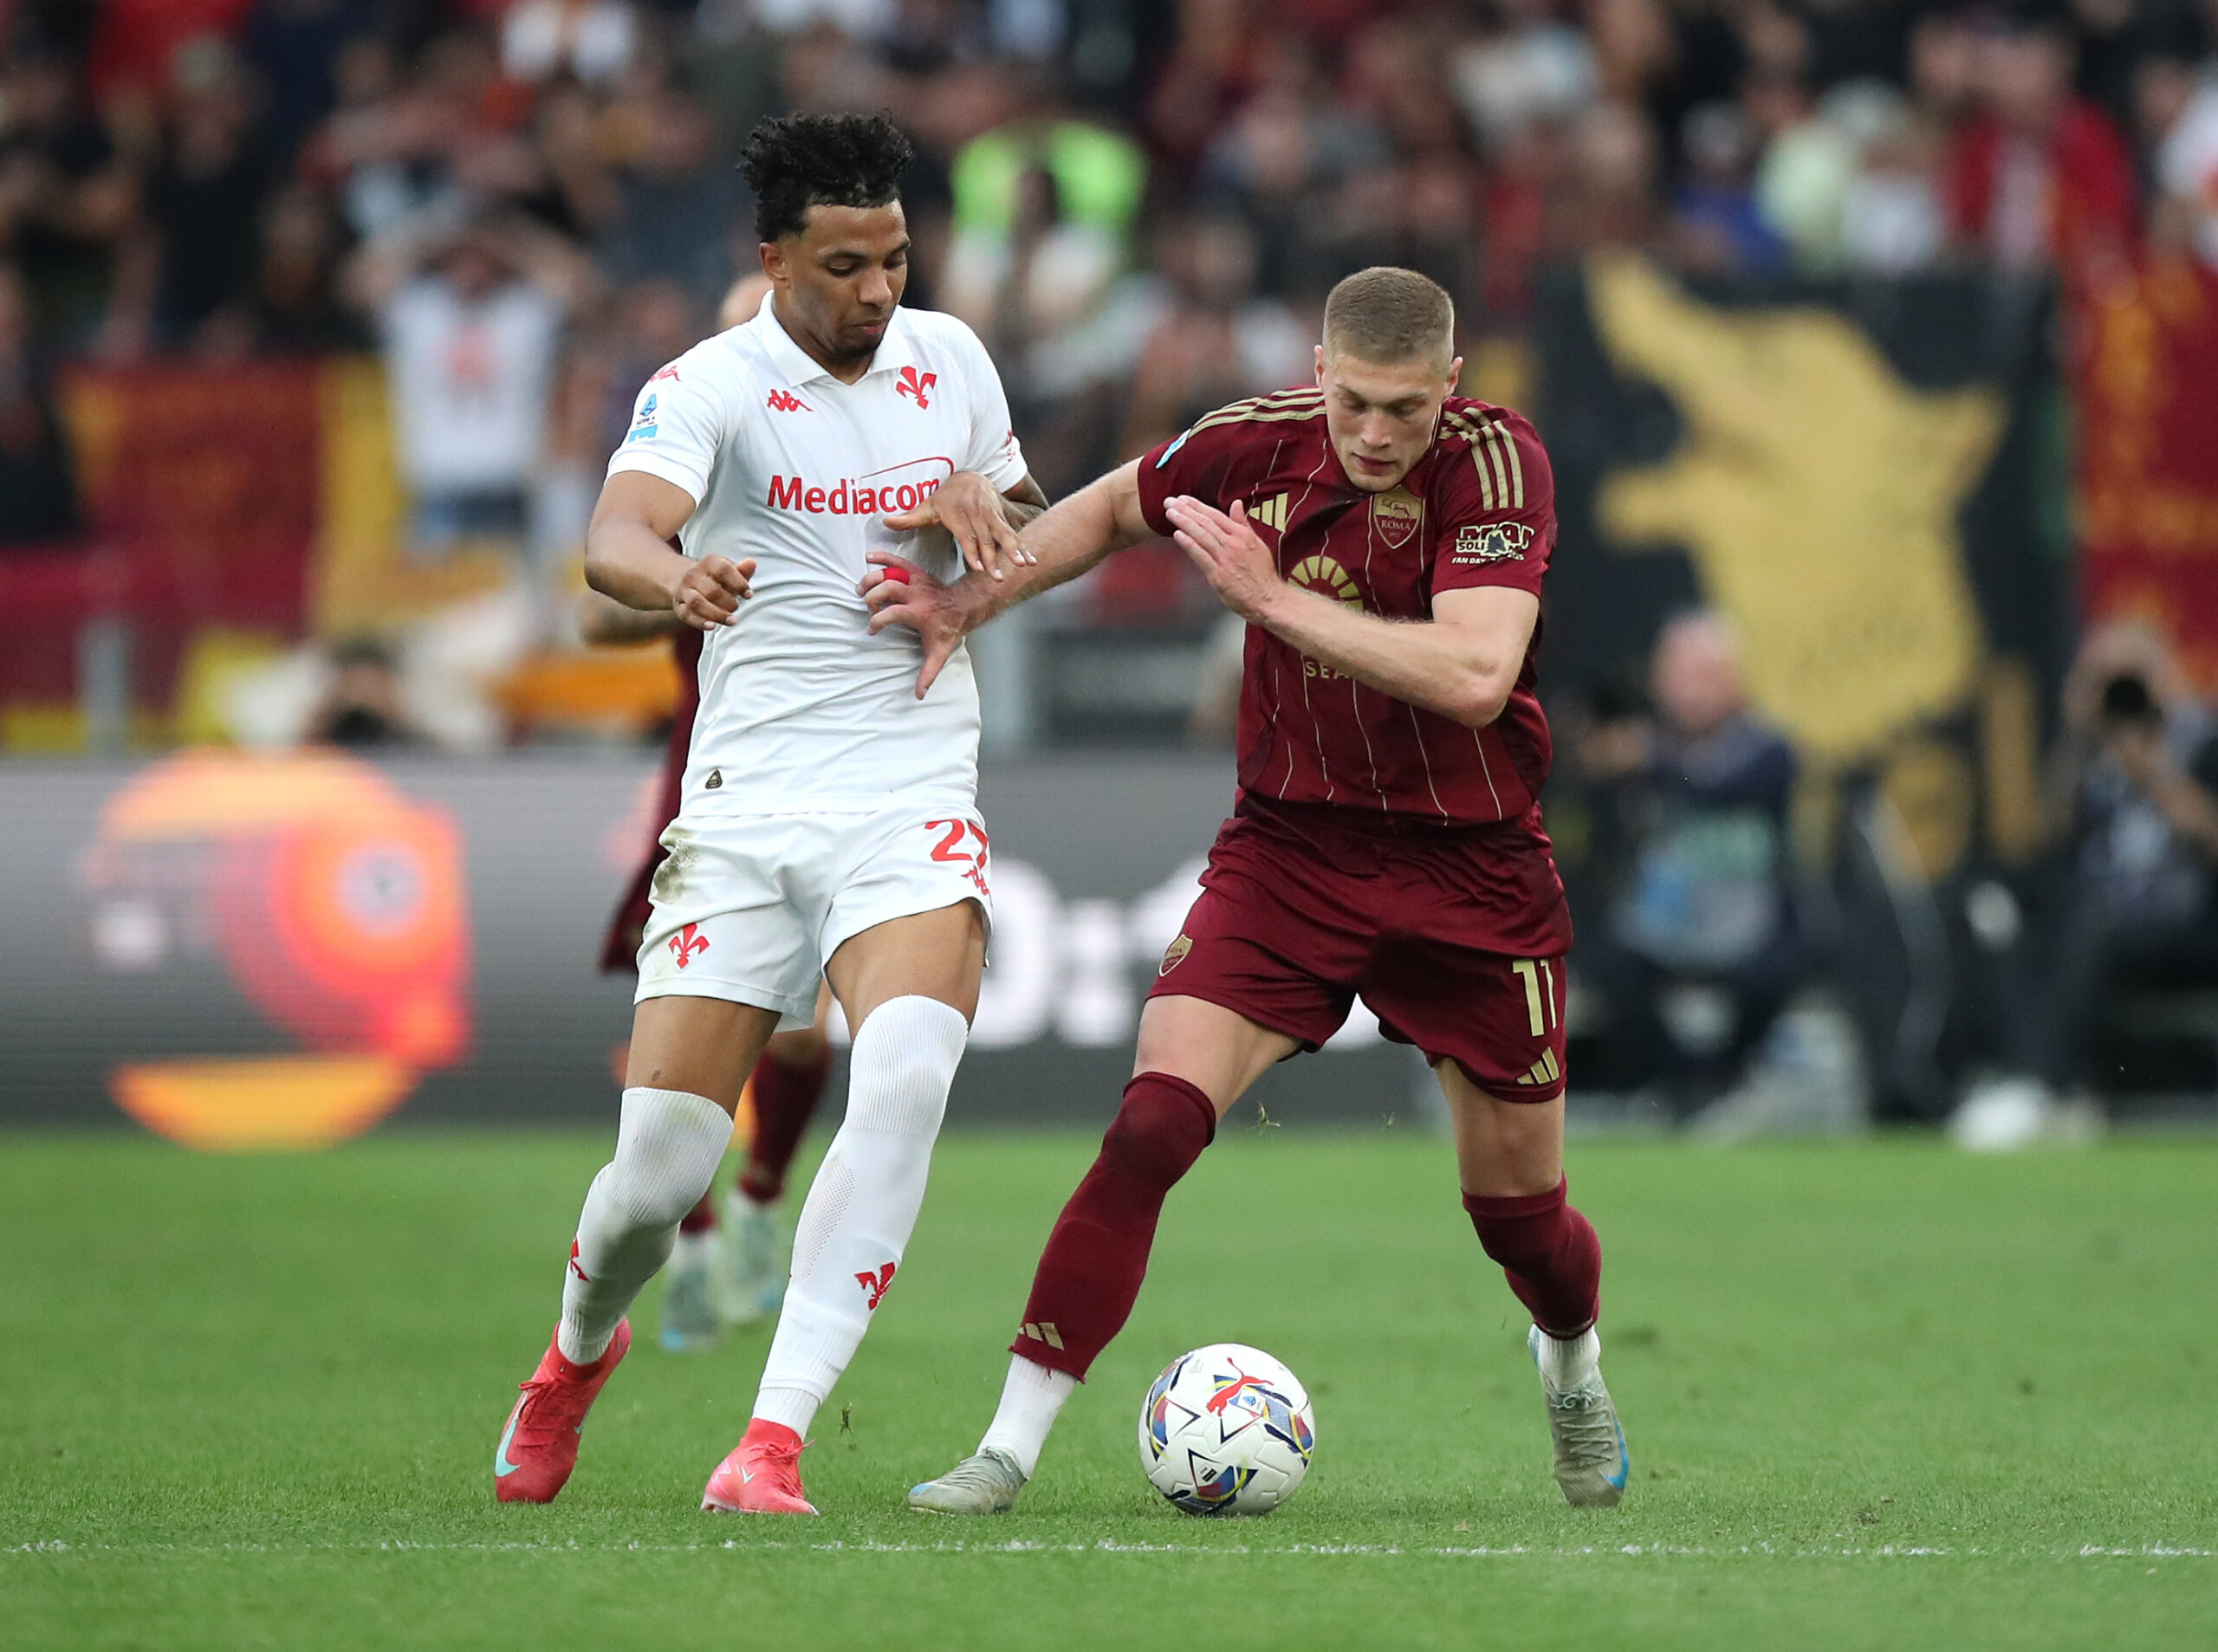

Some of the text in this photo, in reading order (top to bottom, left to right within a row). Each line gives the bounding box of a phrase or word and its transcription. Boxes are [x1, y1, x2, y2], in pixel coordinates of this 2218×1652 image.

[767, 475, 939, 514] Mediacom
[1381, 520, 1411, 531] ROMA
[1512, 959, 1557, 1036] 11
